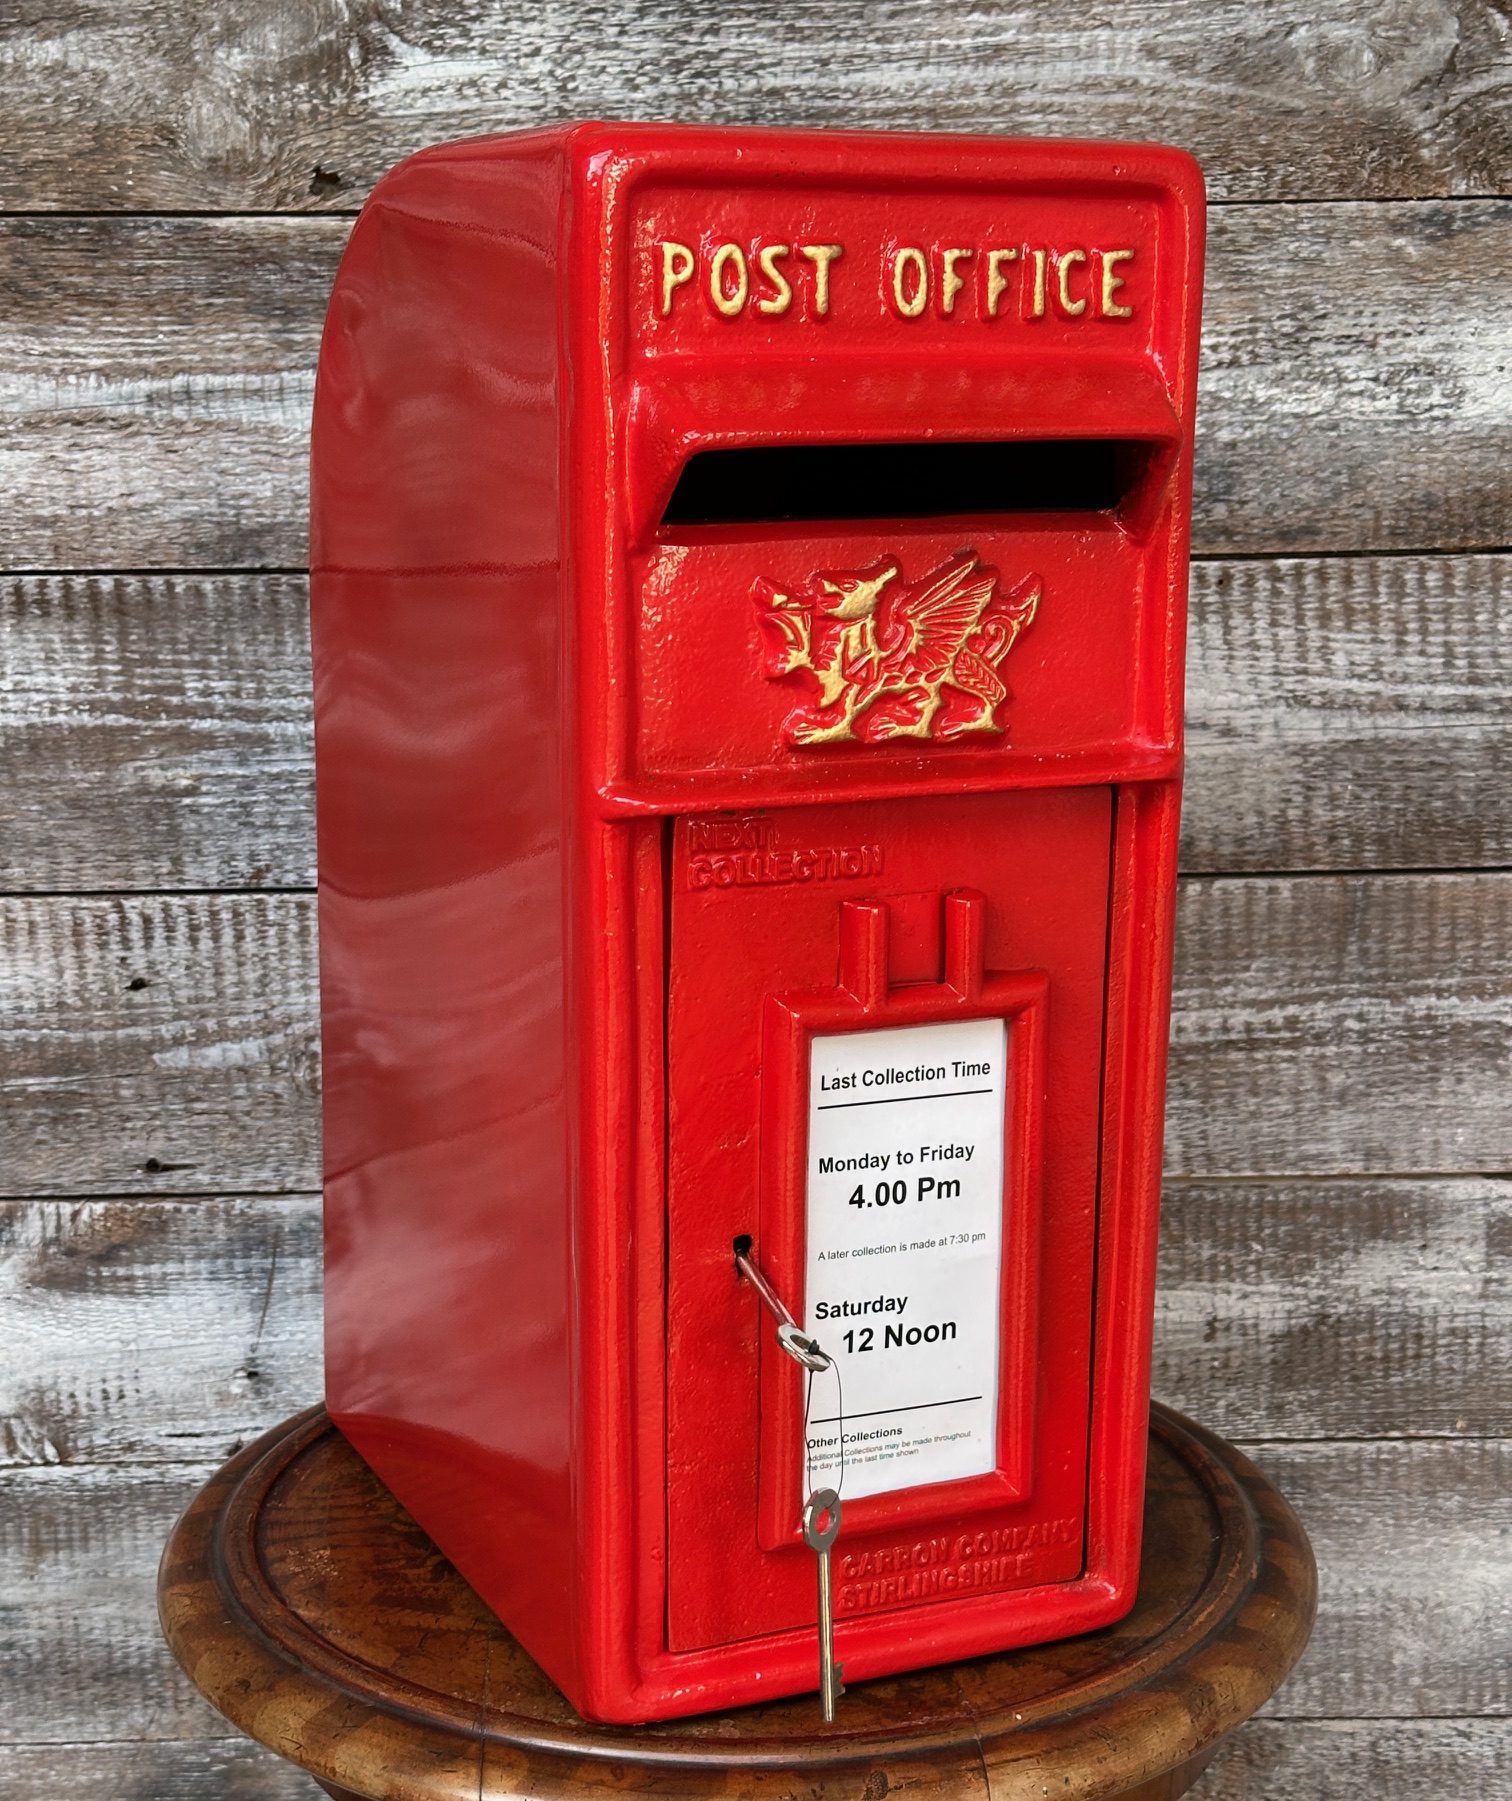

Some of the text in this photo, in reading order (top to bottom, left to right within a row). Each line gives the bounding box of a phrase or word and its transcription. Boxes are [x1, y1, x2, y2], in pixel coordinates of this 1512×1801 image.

[661, 241, 1135, 319] POST OFFICE
[687, 817, 780, 851] NEXT
[687, 844, 884, 890] COLLECTION
[821, 1061, 991, 1091] Last Collection Time
[819, 1144, 975, 1174] Monday to Friday
[849, 1177, 961, 1209] 4.00 Pm
[818, 1232, 986, 1261] A later collection is made at 7:30 pm
[815, 1295, 908, 1320] Saturday
[842, 1321, 957, 1354] 12 Noon
[807, 1427, 903, 1448] Other Collections
[844, 1445, 883, 1457] Collections
[885, 1442, 900, 1452] may
[902, 1439, 911, 1447] be
[913, 1437, 933, 1445] made
[934, 1430, 972, 1443] throughout
[820, 1460, 833, 1471] day
[852, 1456, 863, 1464] the
[865, 1454, 878, 1462] last
[879, 1451, 894, 1460] time
[896, 1448, 919, 1457] shown
